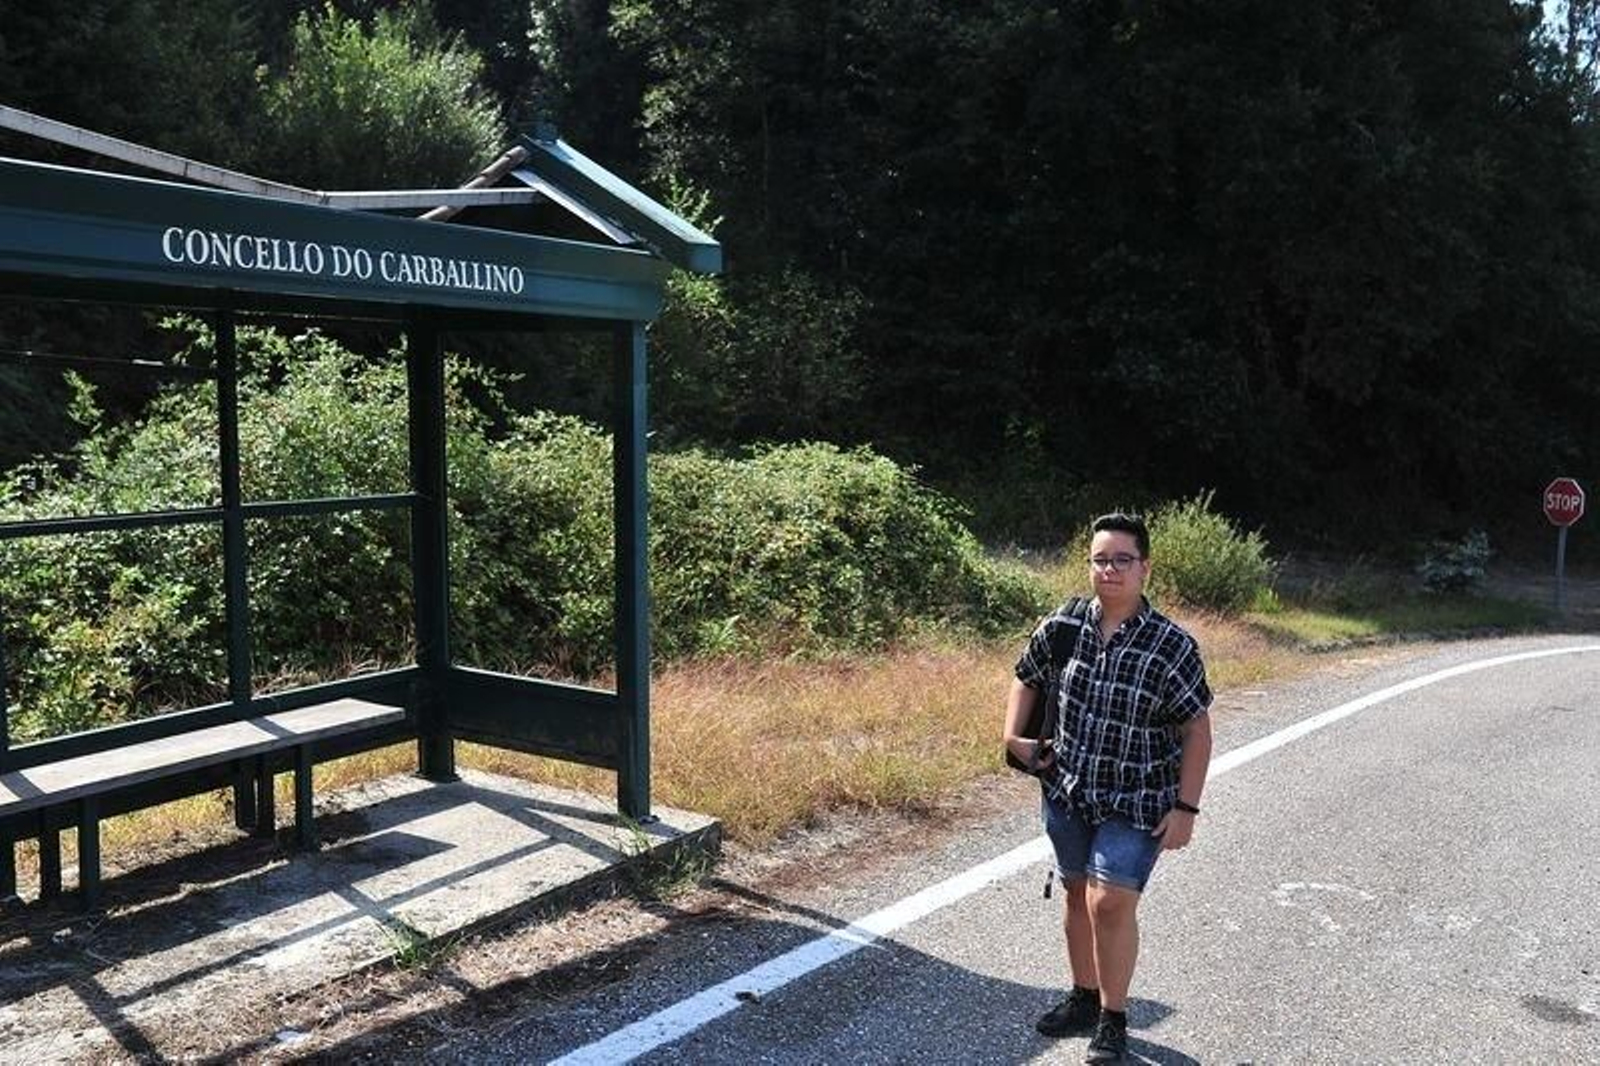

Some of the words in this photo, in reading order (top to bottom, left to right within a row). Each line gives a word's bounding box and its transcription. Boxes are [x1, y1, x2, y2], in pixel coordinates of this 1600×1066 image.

[162, 227, 324, 275] CONCELLO
[331, 245, 373, 280] DO
[380, 251, 524, 294] CARBALLINO
[1547, 493, 1580, 511] STOP
